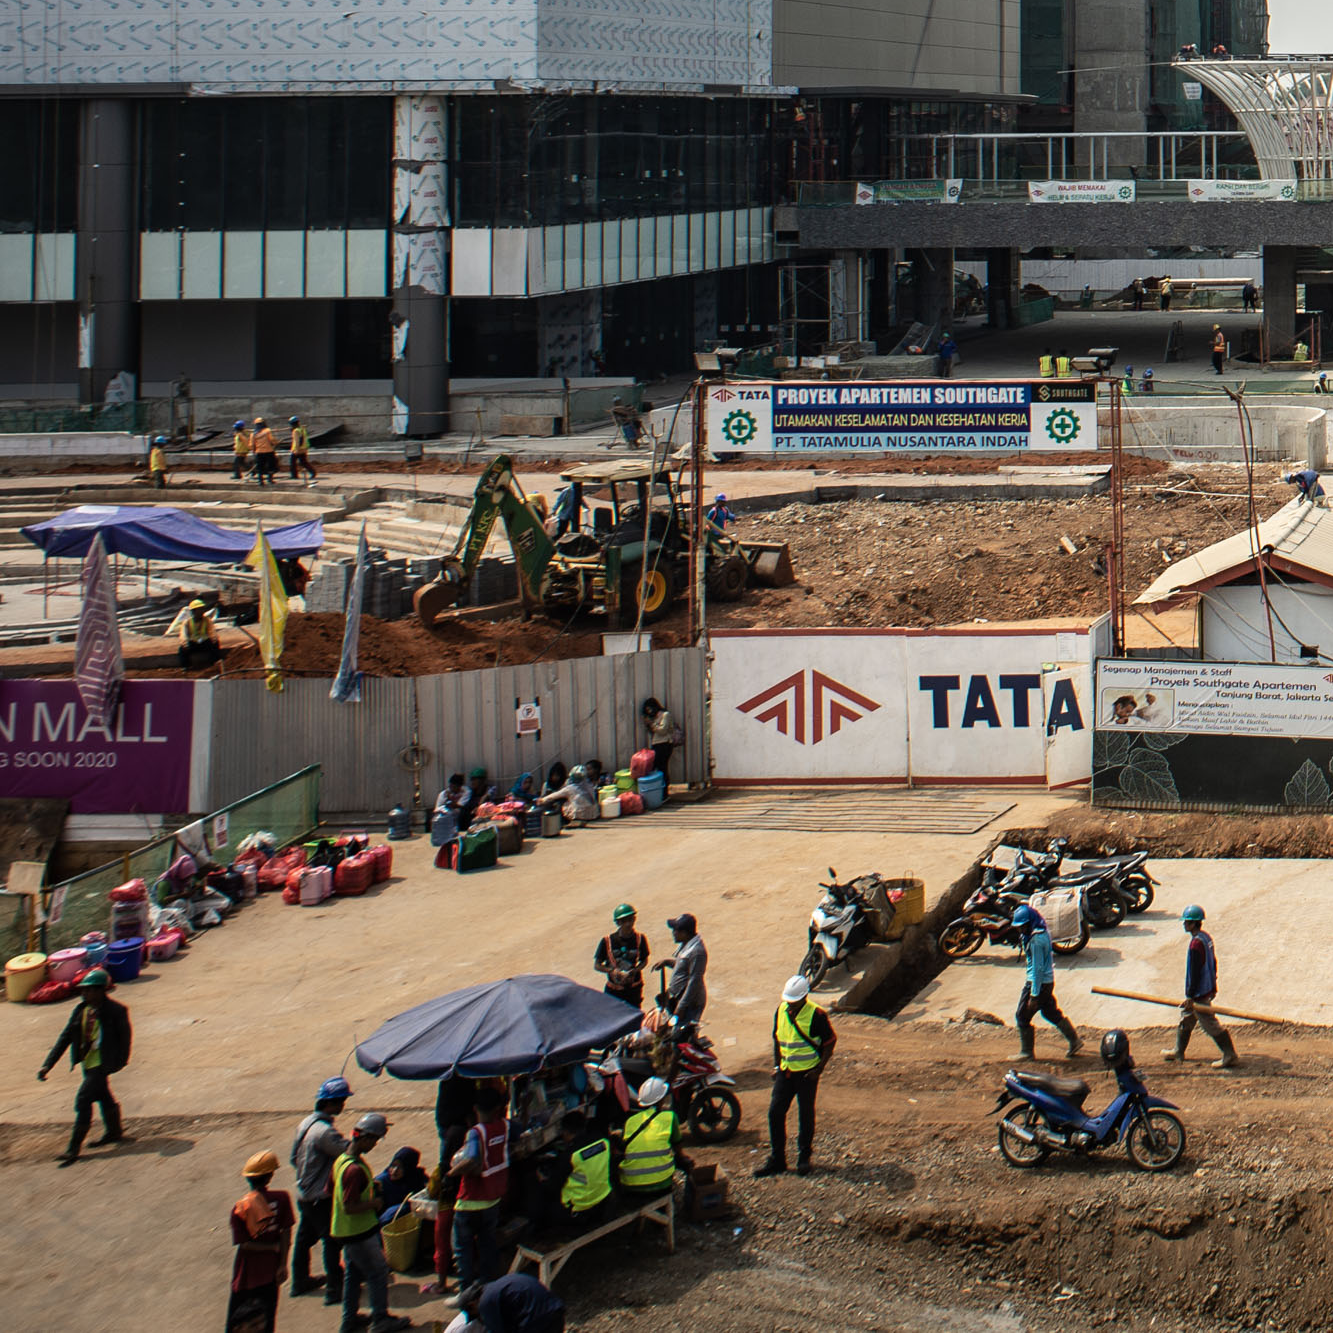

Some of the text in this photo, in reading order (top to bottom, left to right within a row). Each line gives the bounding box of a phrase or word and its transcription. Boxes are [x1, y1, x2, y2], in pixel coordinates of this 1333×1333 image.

[738, 390, 770, 400] TATA
[778, 387, 1025, 404] PROYEK APARTEMEN SOUTHGATE
[1052, 388, 1088, 398] SOUTHGATE
[775, 414, 1028, 427] UTAMAKAN KESELAMATAN DAN KESEHATAN KERJA
[775, 436, 1028, 448] PT. TATAMULIA NUSANTARA INDAH
[1103, 665, 1233, 676] Segenap Manajemen & Staff
[1150, 676, 1317, 691] Proyek Southgate Apartemen
[1216, 690, 1253, 700] Tanjung
[1255, 692, 1284, 701] Barat,
[1286, 693, 1321, 702] Jakarta
[919, 674, 1084, 737] TATA
[32, 702, 168, 743] MALL
[14, 752, 71, 768] SOON
[75, 752, 117, 768] 2020
